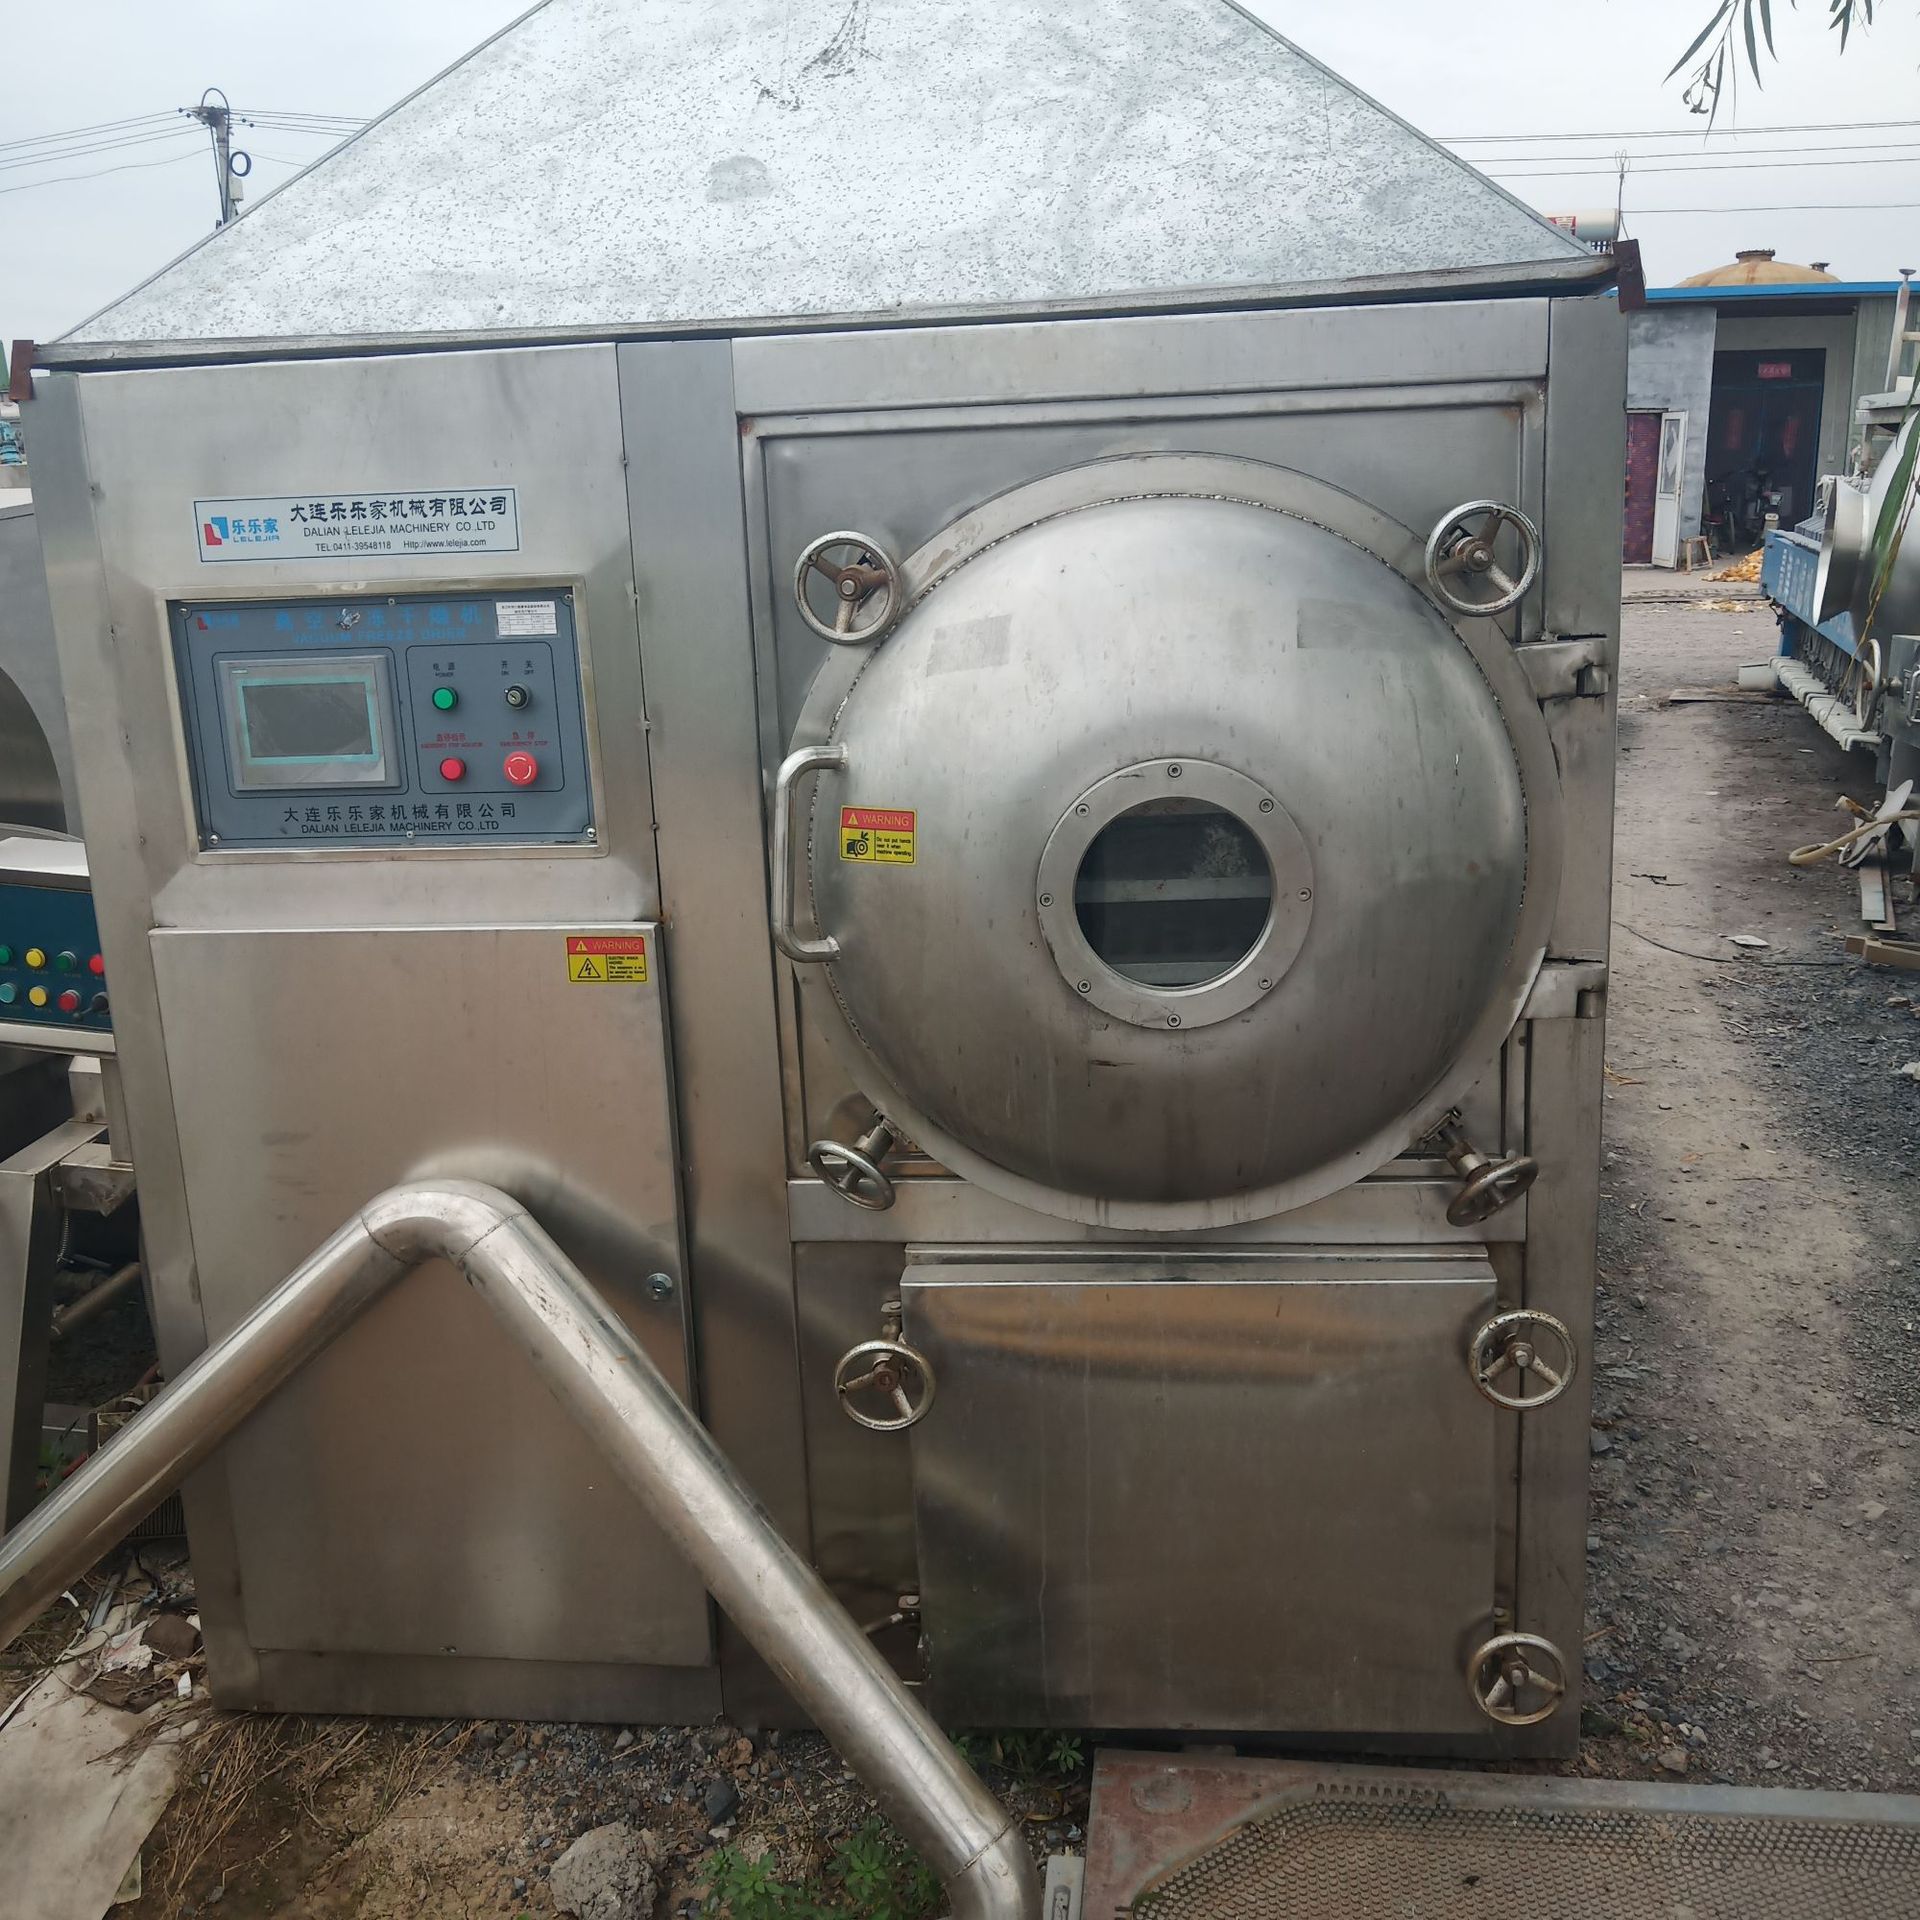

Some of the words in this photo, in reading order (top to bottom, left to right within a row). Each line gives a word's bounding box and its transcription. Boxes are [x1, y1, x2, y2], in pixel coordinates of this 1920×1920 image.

[291, 496, 507, 522] 大连乐乐家机械有限公司
[232, 518, 279, 535] 乐乐家
[303, 526, 341, 537] DALIAN
[346, 524, 386, 536] LELEJIA
[390, 522, 450, 534] MACHINERY
[233, 535, 280, 543] LELEJIA
[284, 803, 516, 822] 大连乐乐家机械有限公司
[862, 813, 910, 827] WARNING
[301, 824, 339, 834] DALIAN
[344, 823, 386, 833] LELEJIA
[390, 821, 452, 832] MACHINERY
[592, 940, 640, 951] WARNING
